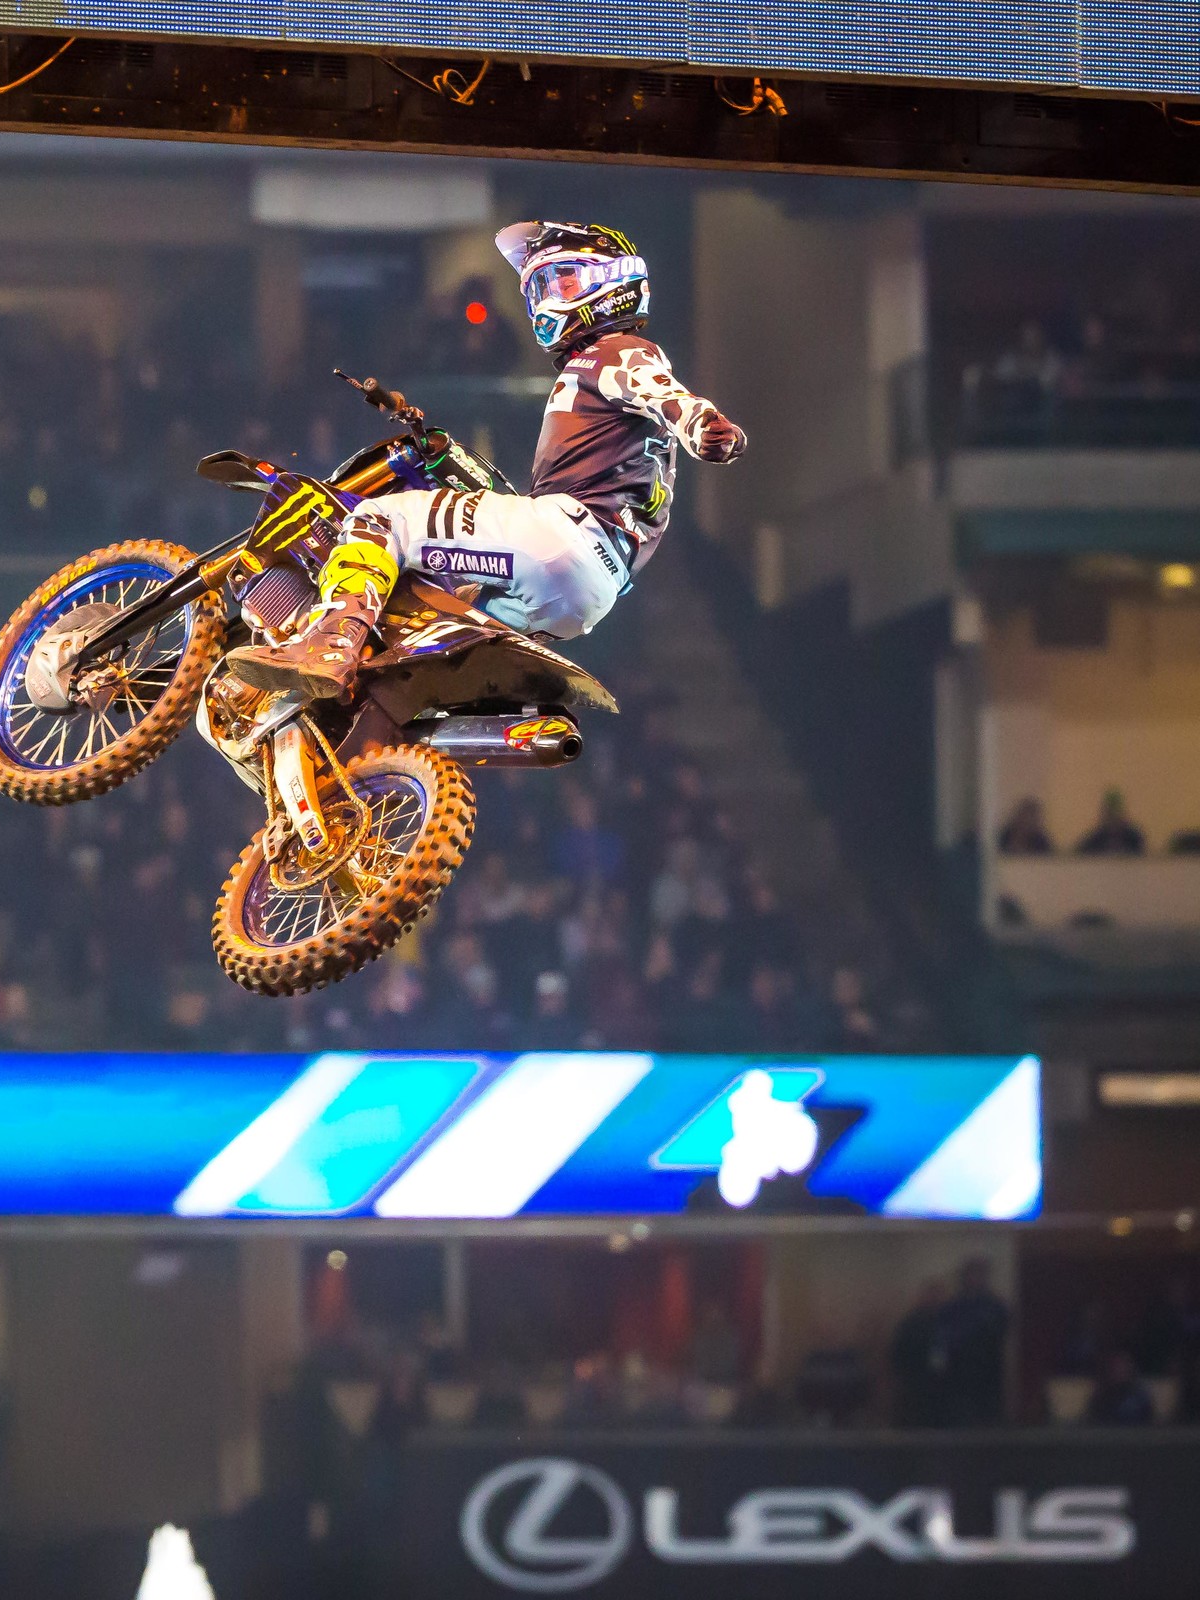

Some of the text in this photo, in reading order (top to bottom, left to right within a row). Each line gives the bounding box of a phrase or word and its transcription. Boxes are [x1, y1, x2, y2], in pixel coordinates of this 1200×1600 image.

[594, 289, 637, 313] MONSTER
[448, 553, 508, 576] YAMAHA
[592, 541, 620, 575] THOR
[644, 1487, 1136, 1564] LEXUS
